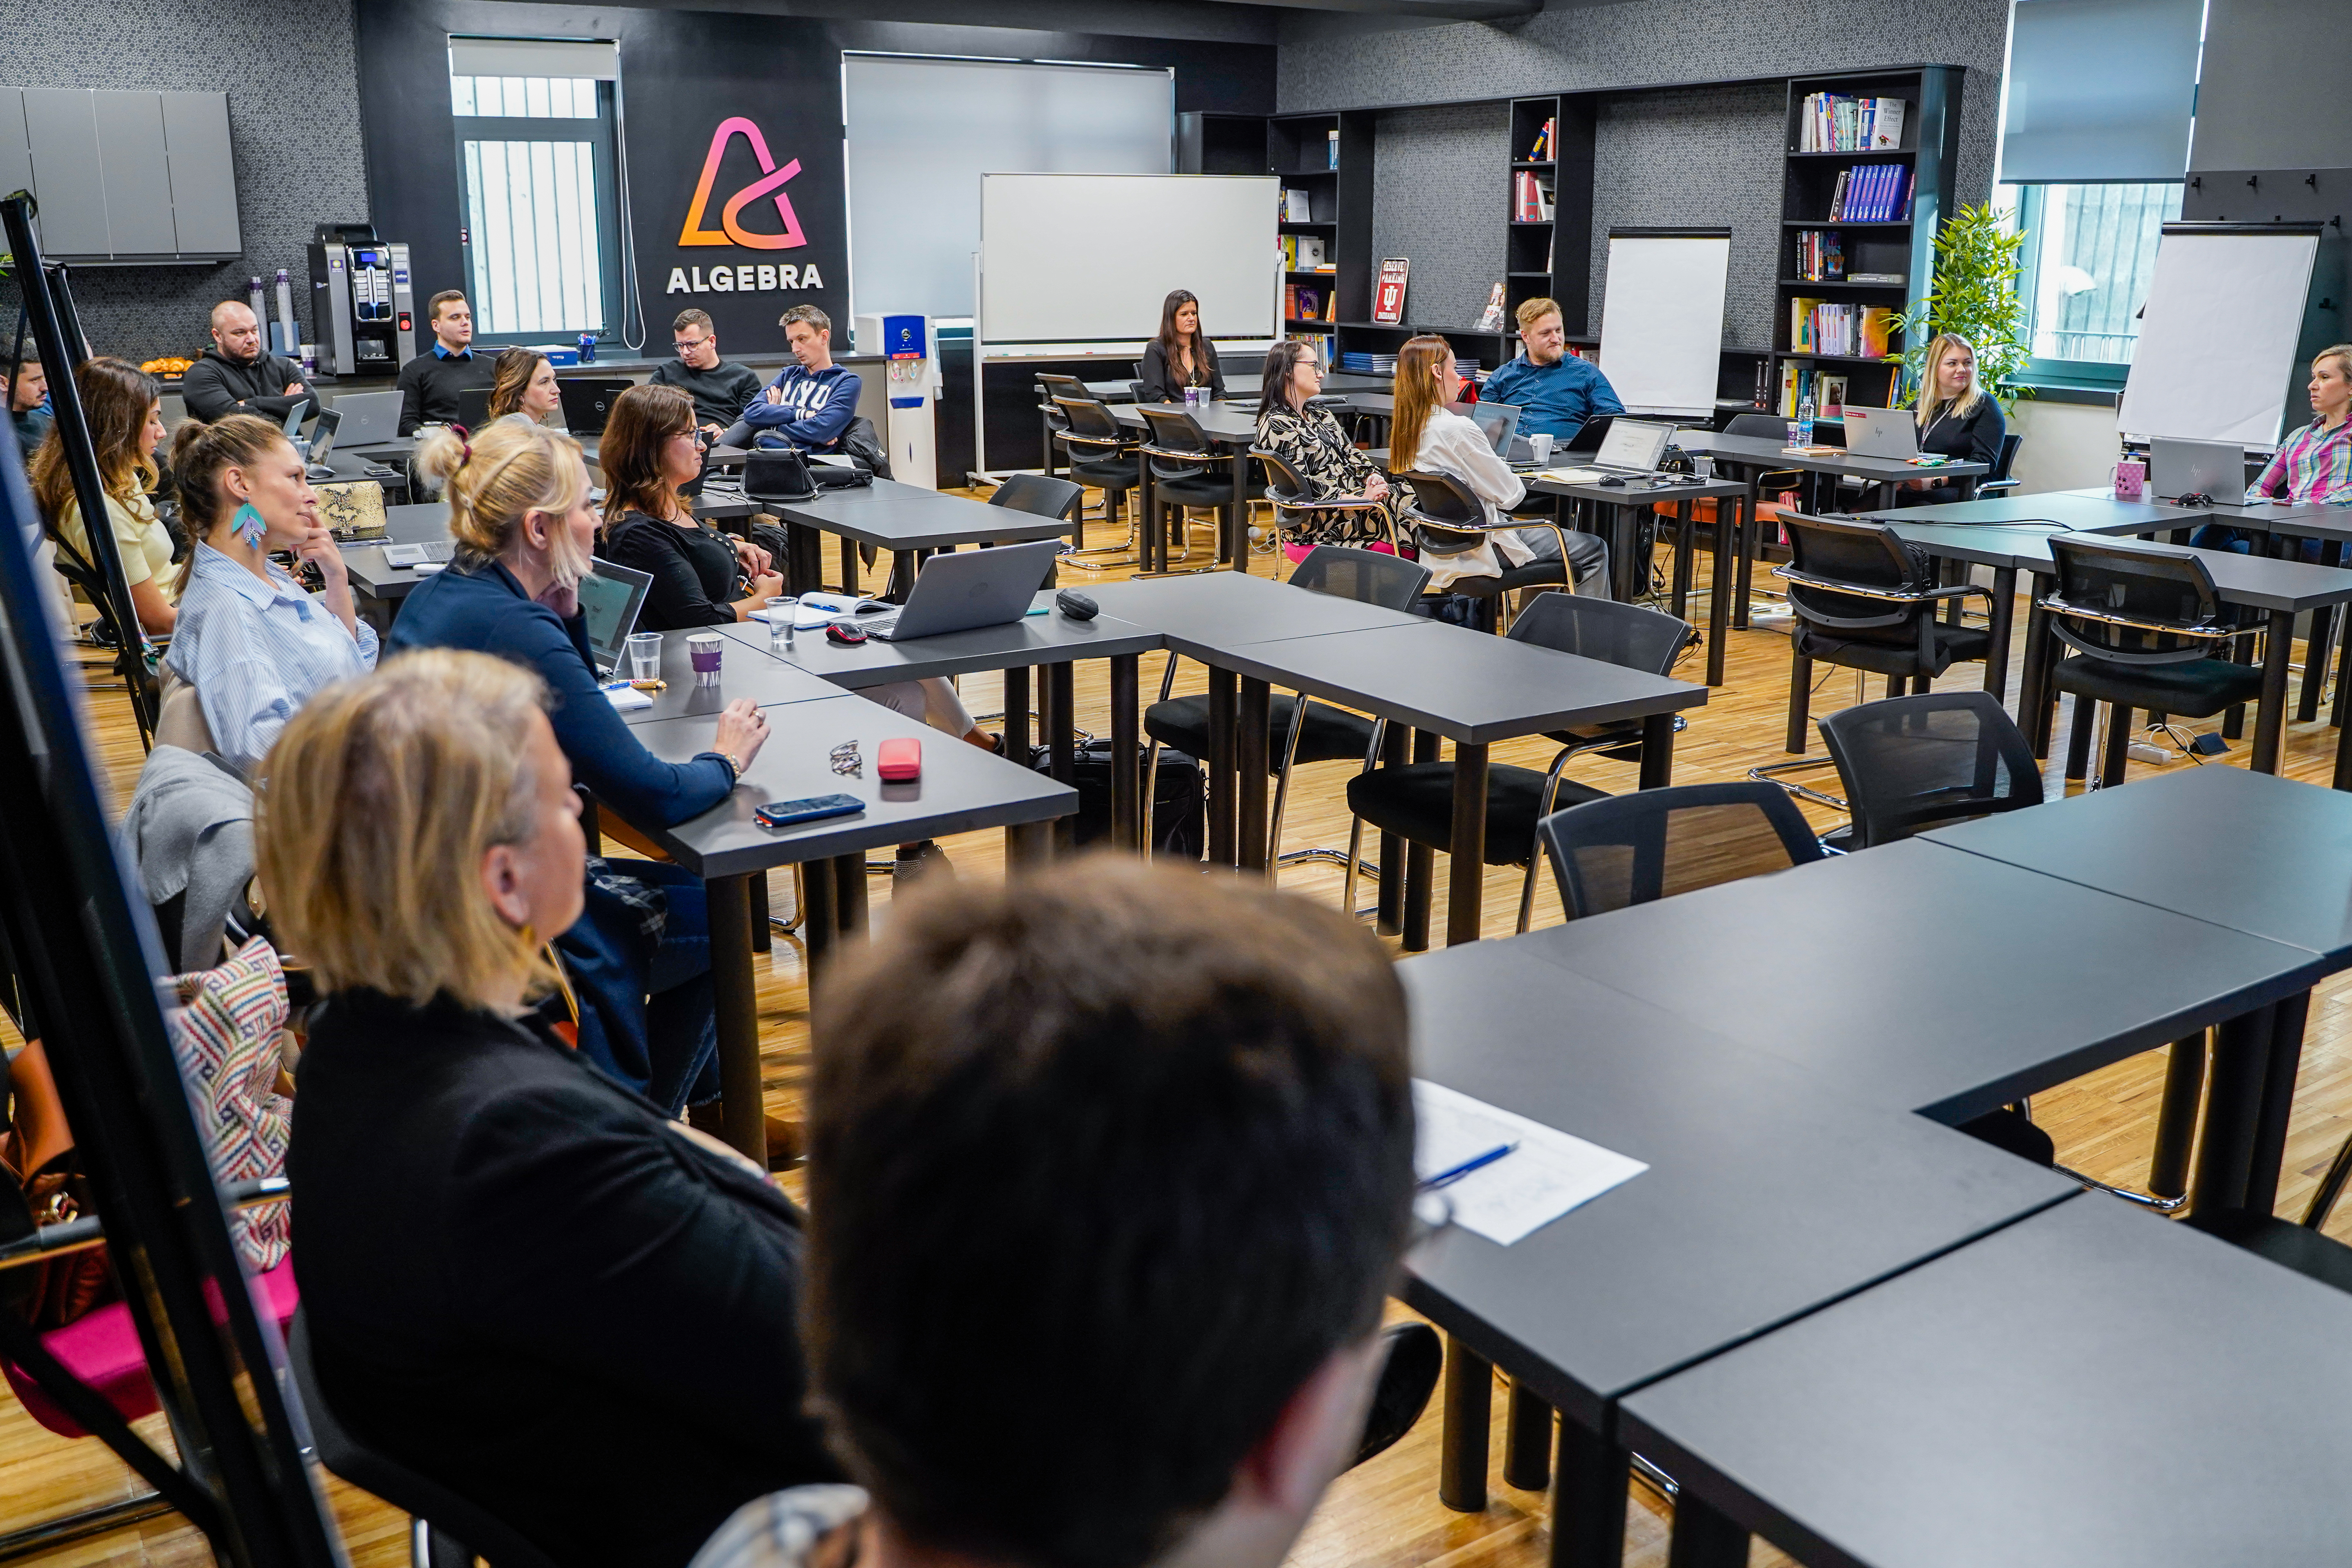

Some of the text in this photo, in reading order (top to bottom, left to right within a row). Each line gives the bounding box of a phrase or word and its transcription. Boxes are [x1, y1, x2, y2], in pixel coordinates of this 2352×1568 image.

[667, 264, 823, 294] ALGEBRA
[1381, 272, 1405, 284] PARKING
[1377, 312, 1397, 320] INDIANA
[780, 380, 832, 411] NYU
